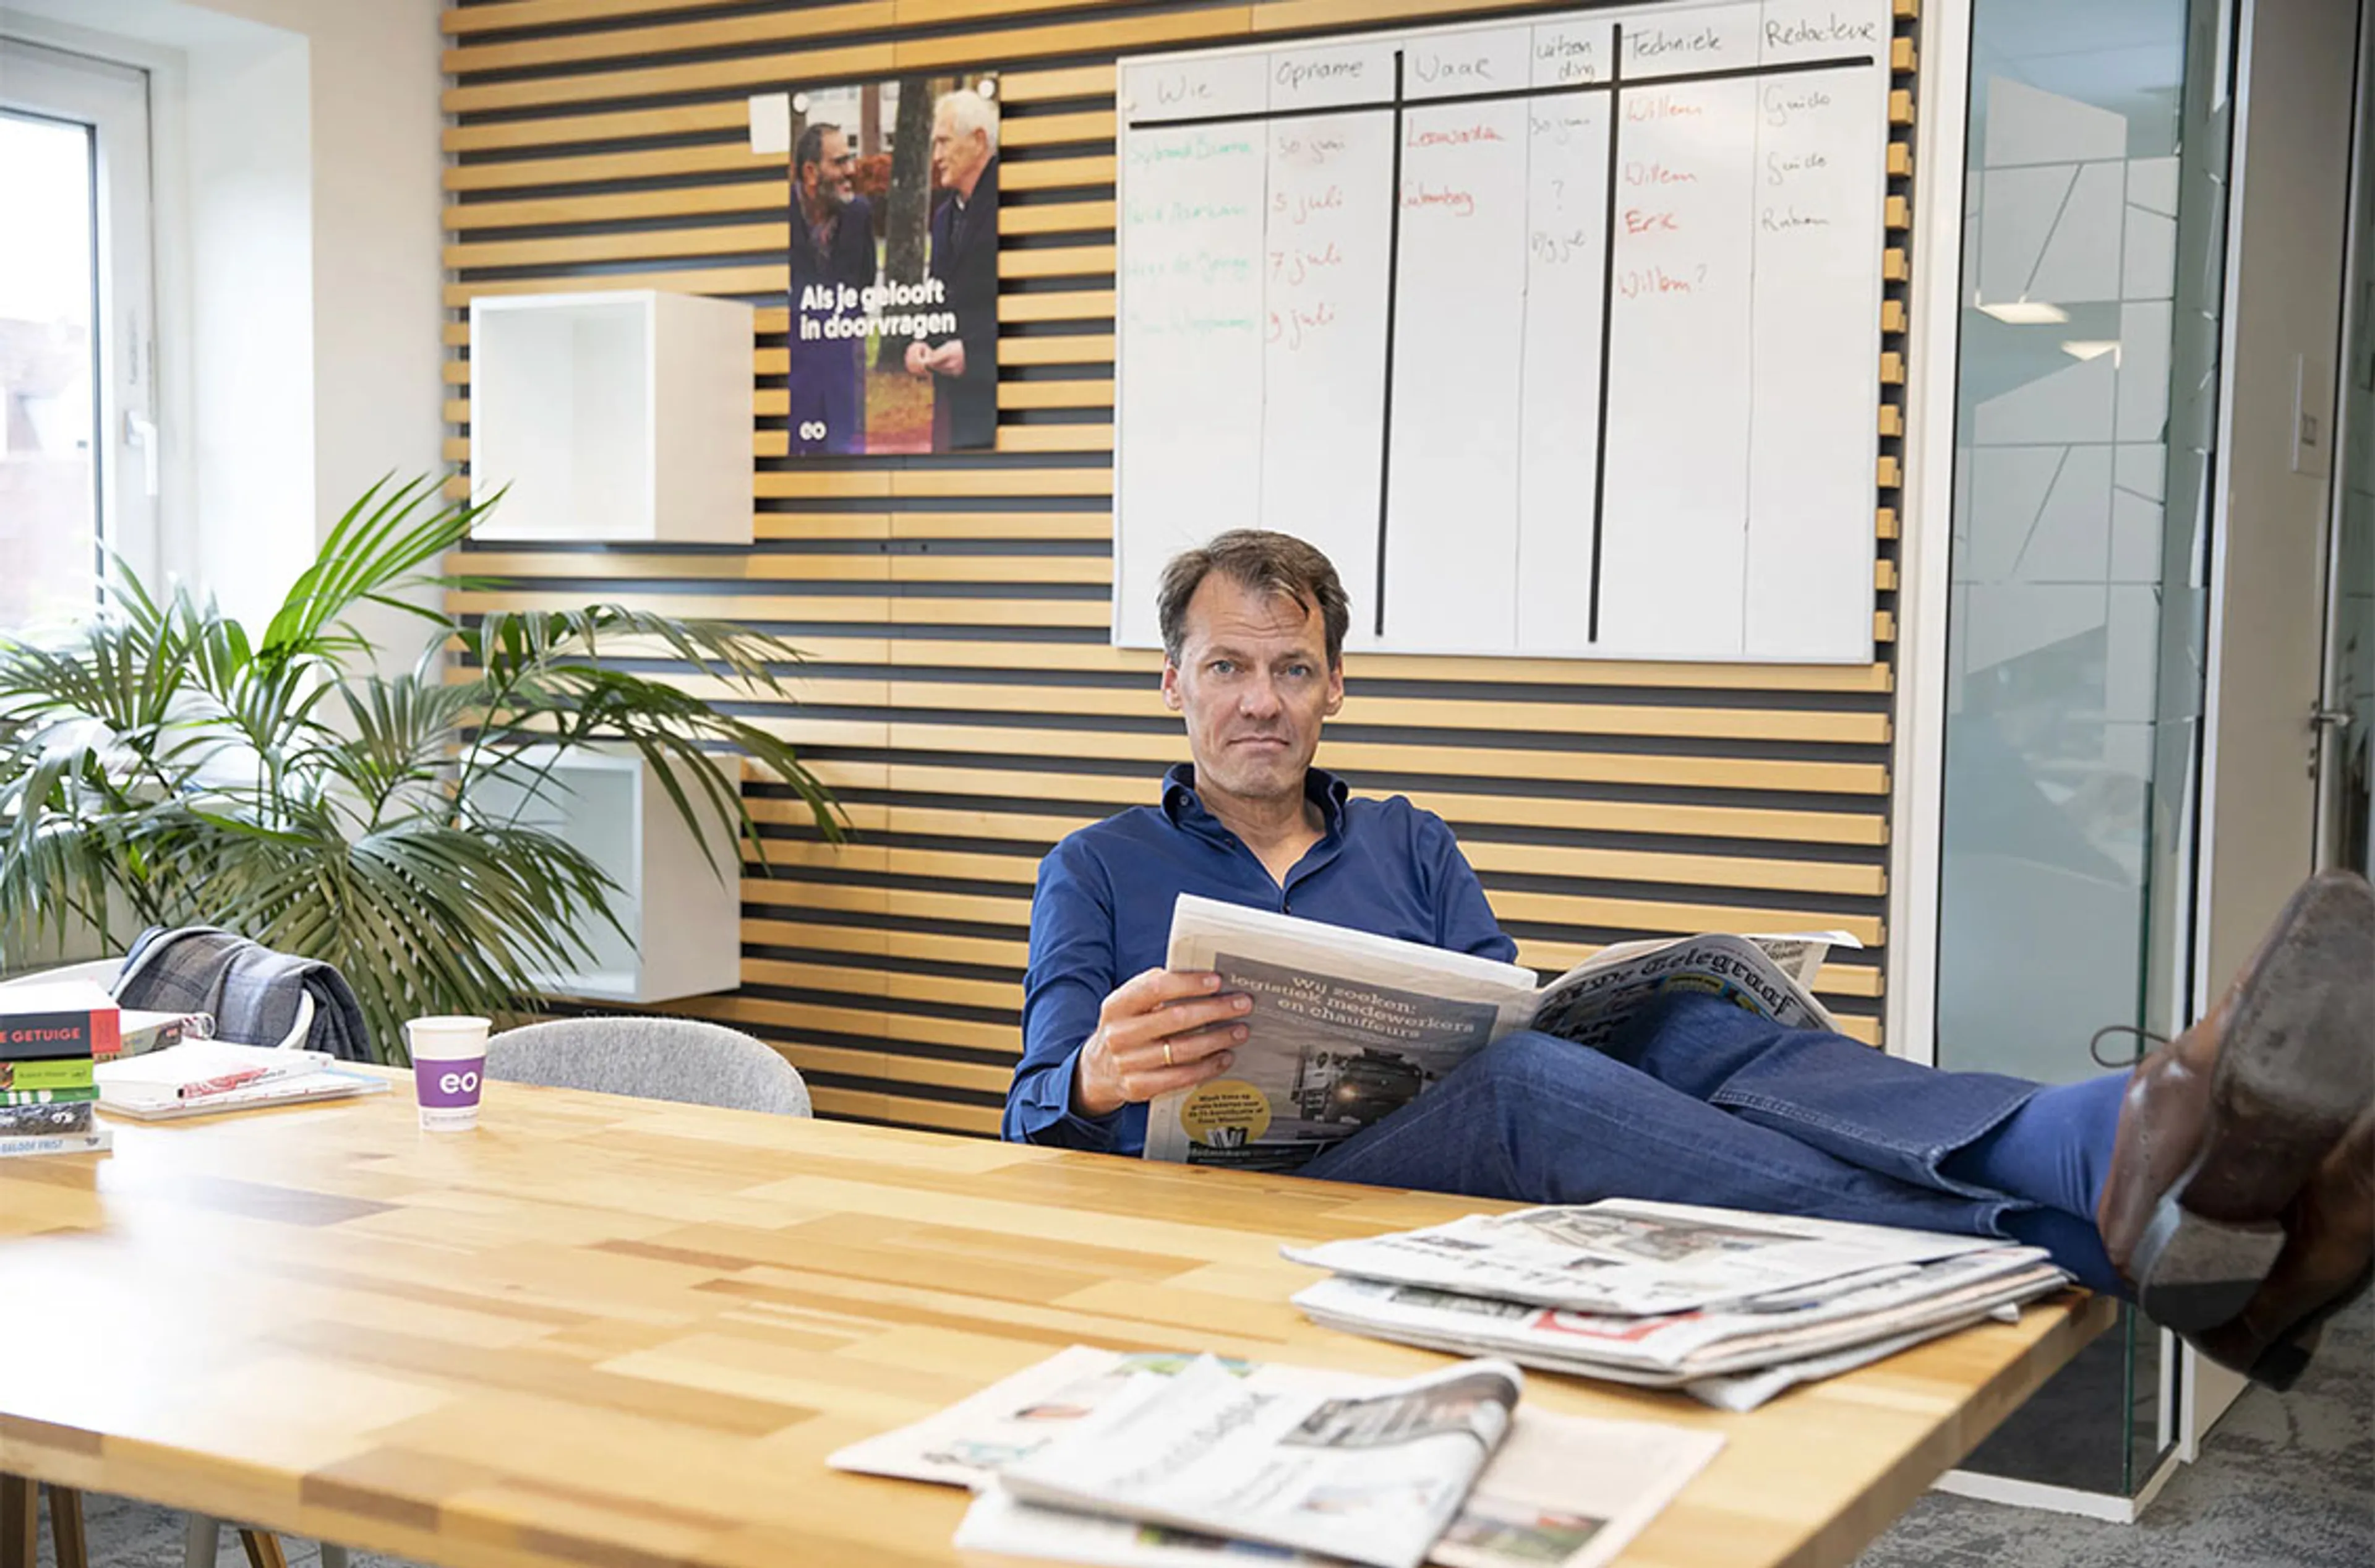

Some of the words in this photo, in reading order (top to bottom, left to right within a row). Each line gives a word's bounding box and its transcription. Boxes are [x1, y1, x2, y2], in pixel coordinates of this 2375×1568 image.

[1623, 31, 1723, 60] Techniek
[1277, 60, 1364, 88] Opname
[1414, 56, 1494, 82] Waar
[1157, 75, 1213, 103] Wie
[1295, 186, 1343, 225] juli
[1270, 251, 1285, 280] 7
[1289, 242, 1342, 286] juli
[800, 283, 836, 311] Als
[836, 282, 858, 314] je
[861, 280, 945, 314] gelooft
[800, 315, 820, 341] in
[824, 311, 957, 340] doorvragen
[1289, 303, 1336, 351] juli
[800, 421, 826, 440] eo
[1292, 977, 1328, 993] Wij
[1332, 986, 1417, 1015] zoeken:
[1640, 948, 1798, 1016] Telegraaf
[1230, 974, 1322, 1005] logistiek
[1326, 997, 1475, 1033] medewerkers
[1277, 998, 1304, 1013] en
[1309, 1005, 1421, 1039] chauffeurs
[12, 1027, 80, 1043] GETUIGE
[439, 1071, 478, 1094] eo
